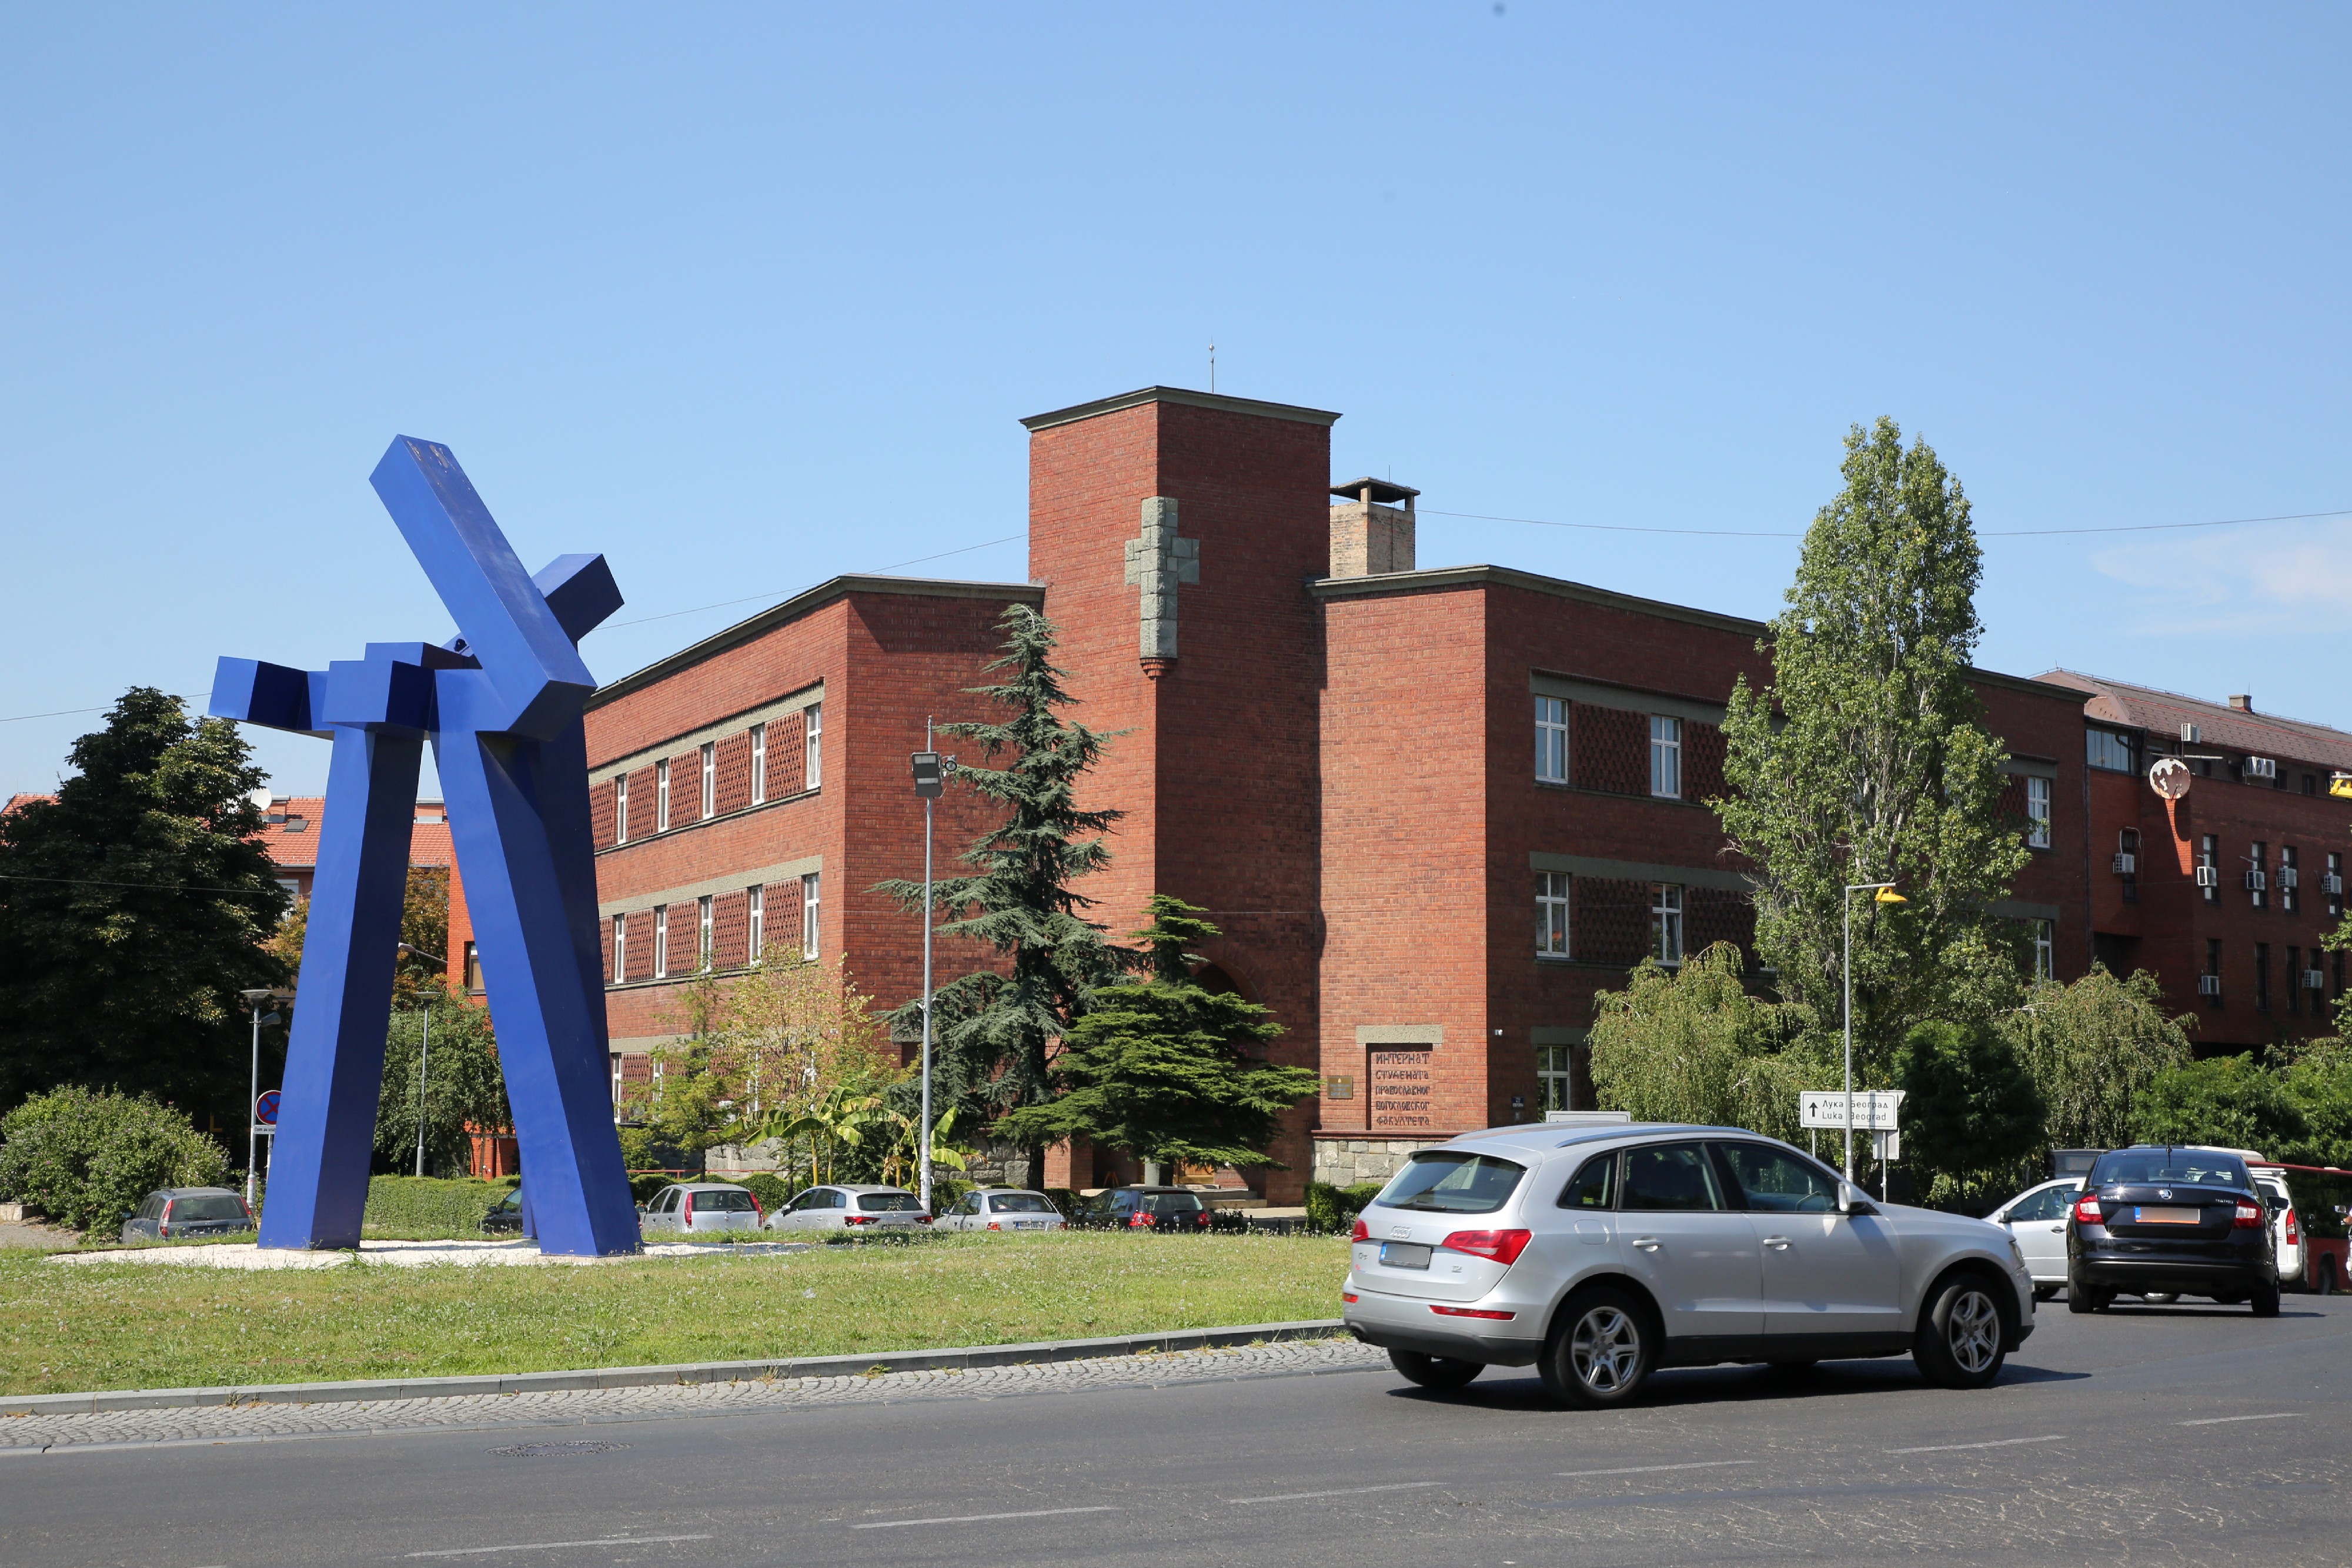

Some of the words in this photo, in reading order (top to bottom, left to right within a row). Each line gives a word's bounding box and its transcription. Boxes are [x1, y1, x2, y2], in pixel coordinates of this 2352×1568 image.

[1376, 1053, 1429, 1064] ИНТЕРНАТ
[1375, 1070, 1429, 1080] СТУДЕНАТА
[1375, 1086, 1430, 1095] ПРАВОСЛАВНОГ
[1376, 1101, 1430, 1111] БОГОСЛОВСКОГ
[1822, 1099, 1843, 1109] Лука
[1377, 1116, 1429, 1126] ФАКУЛТЕТА
